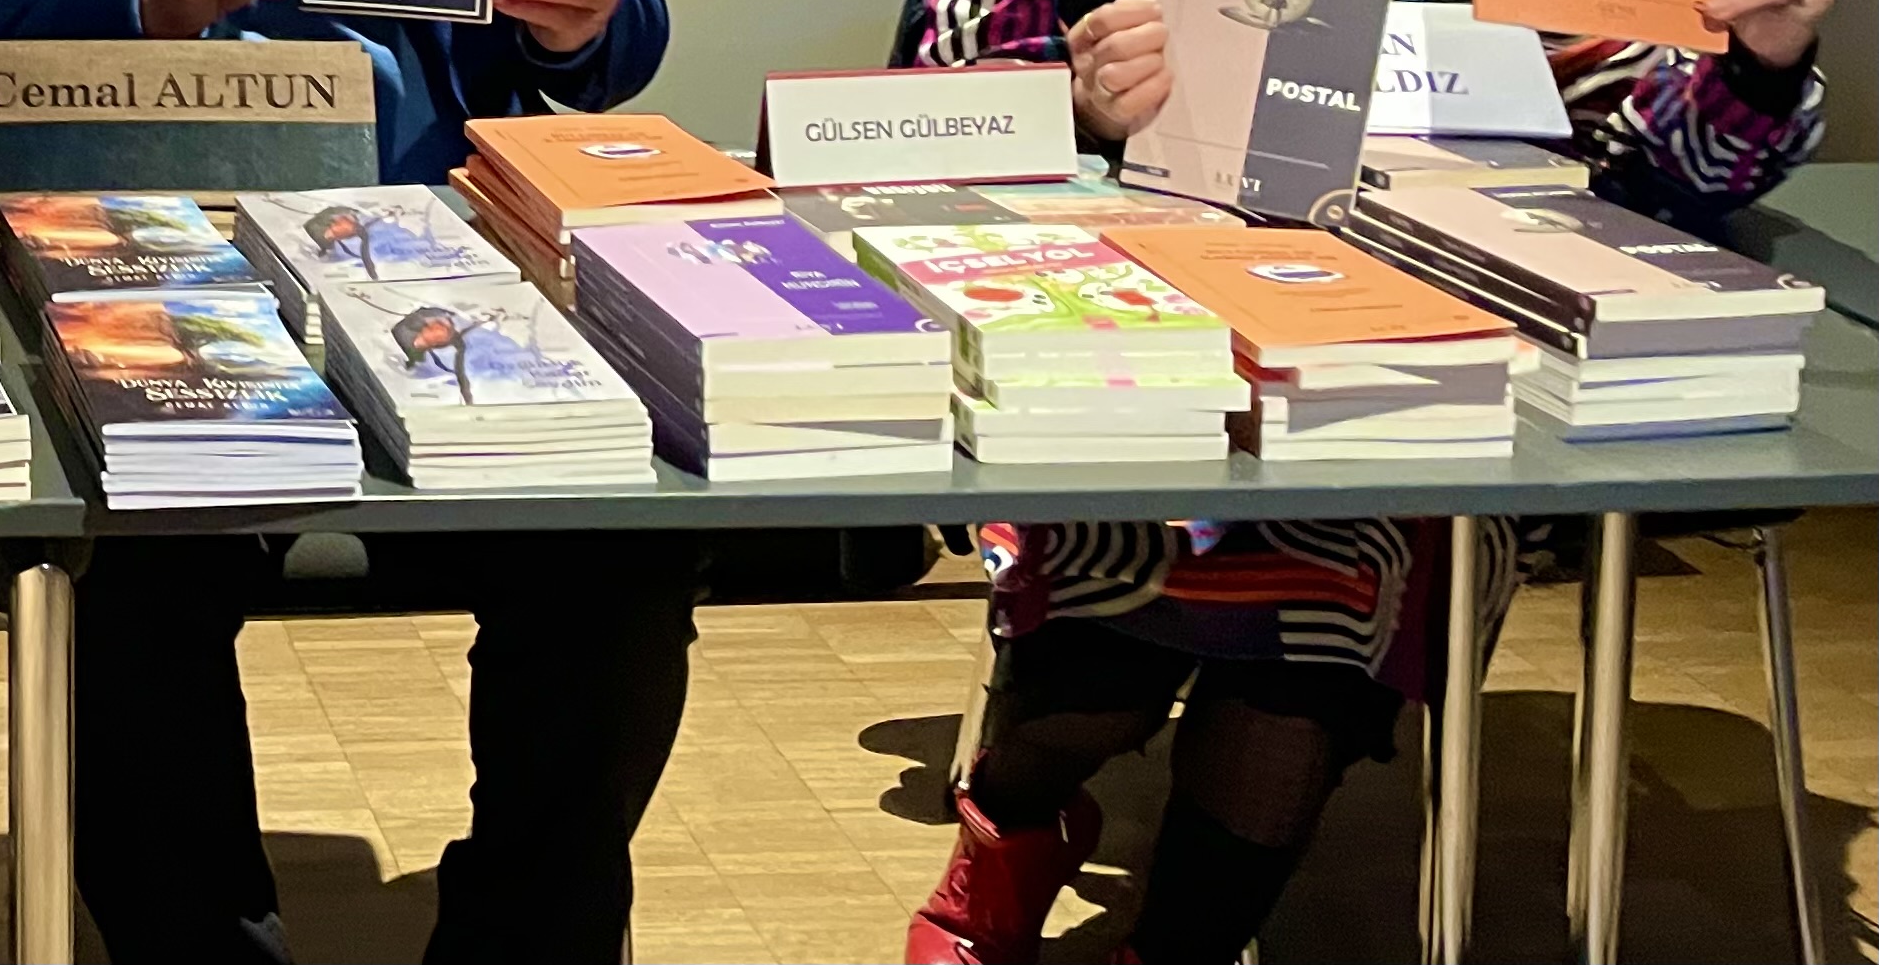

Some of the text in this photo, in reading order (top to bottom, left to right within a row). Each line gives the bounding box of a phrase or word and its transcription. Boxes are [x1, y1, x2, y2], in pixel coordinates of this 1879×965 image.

[156, 72, 340, 110] ALTUN
[1266, 77, 1361, 112] POSTAL
[805, 113, 1016, 143] GÜLSEN GÜLBEYAZ
